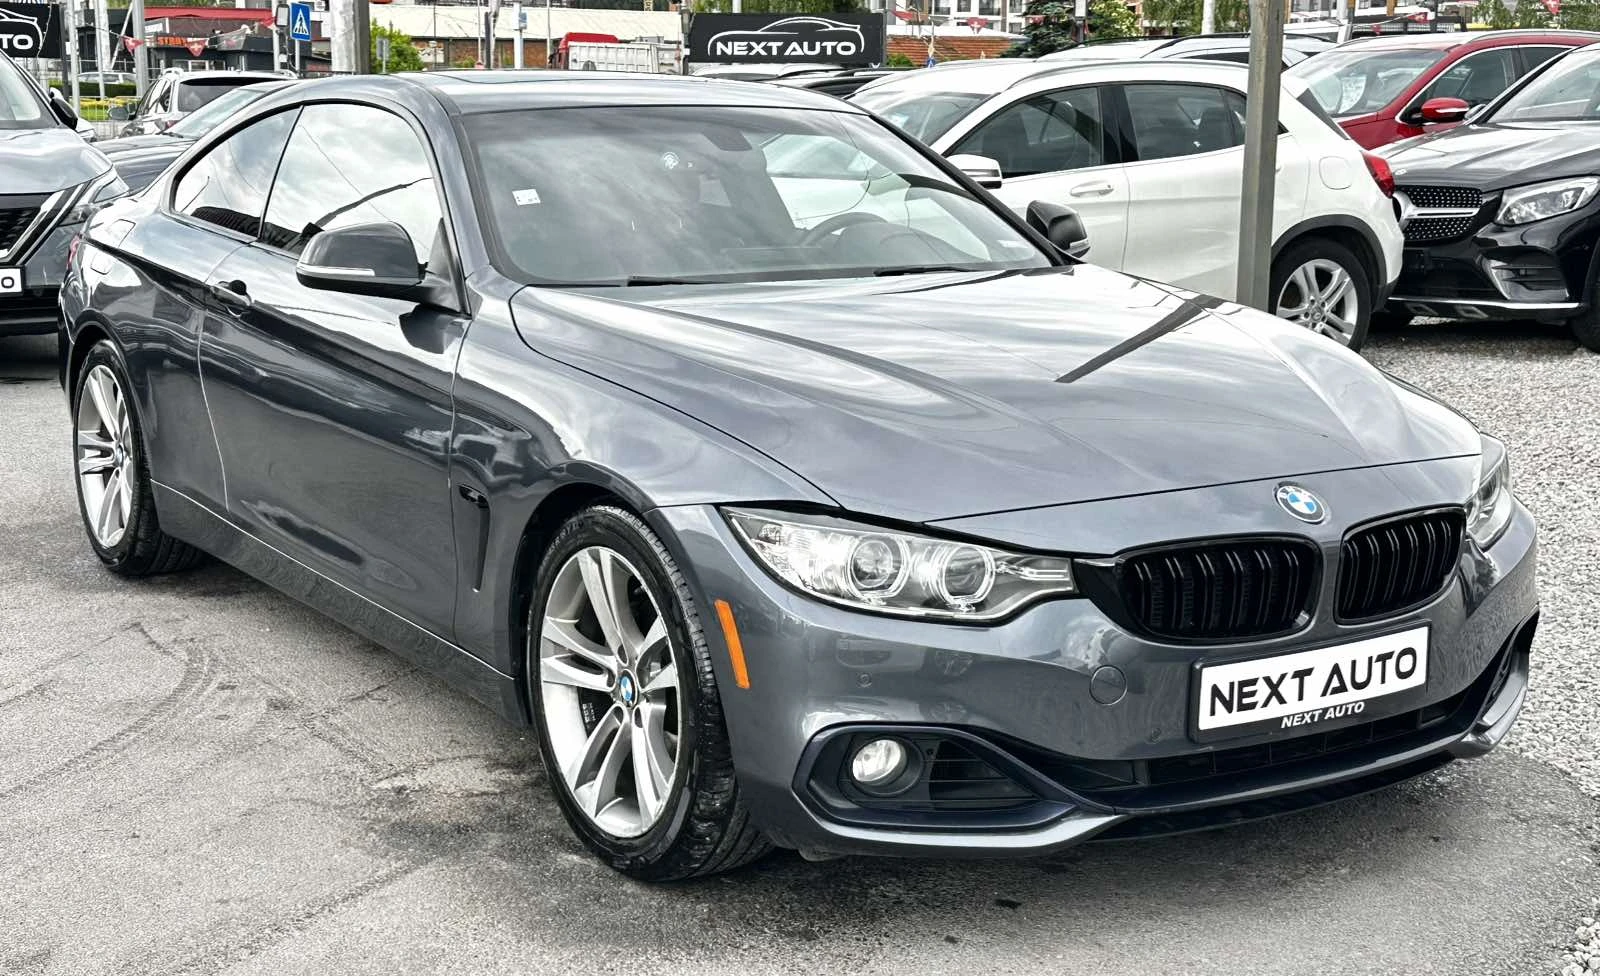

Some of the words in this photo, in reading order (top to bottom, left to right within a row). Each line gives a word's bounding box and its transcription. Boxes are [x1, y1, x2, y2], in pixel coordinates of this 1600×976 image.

[716, 41, 784, 56] NEXT
[783, 41, 857, 56] AUTO
[1209, 667, 1315, 717] NEXT
[1320, 647, 1417, 698] AUTO
[1280, 709, 1323, 729] NEXT
[1324, 701, 1365, 720] AUTO
